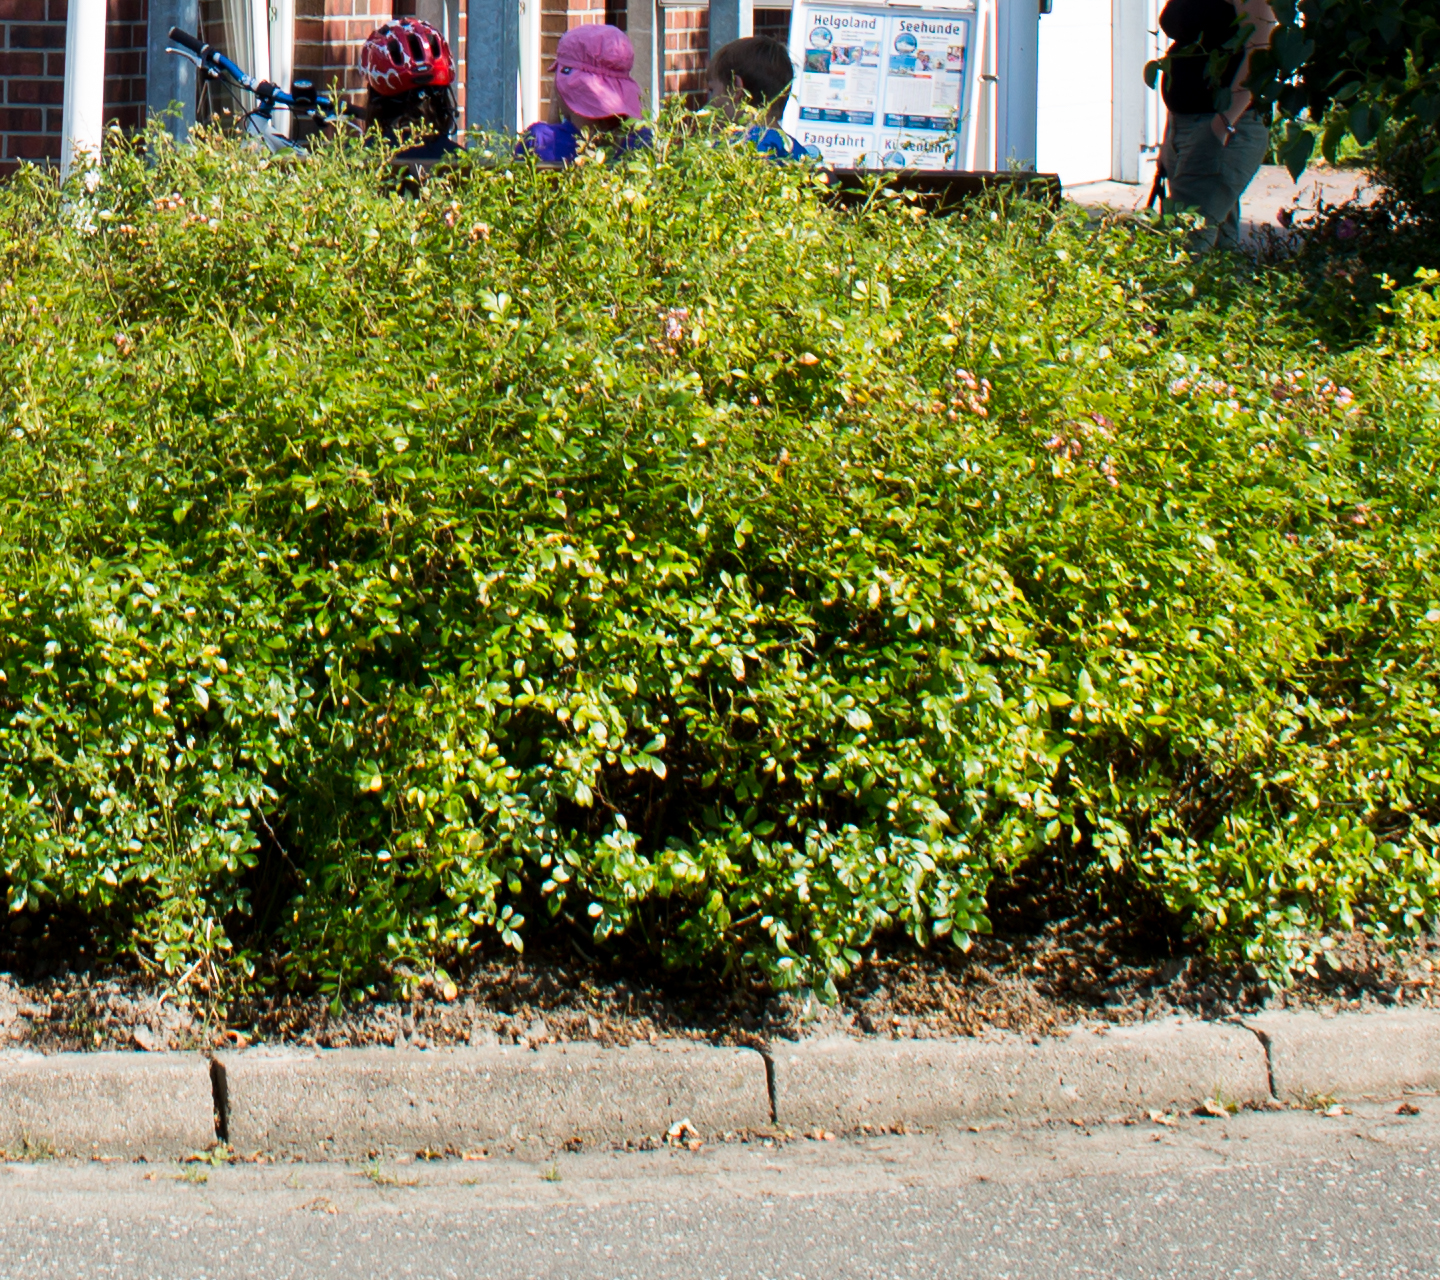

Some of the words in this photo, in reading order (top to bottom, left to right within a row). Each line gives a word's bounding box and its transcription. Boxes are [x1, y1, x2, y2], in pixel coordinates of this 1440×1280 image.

[813, 14, 876, 29] Helgoland
[899, 20, 960, 35] Seehunde
[804, 131, 865, 148] Fangfahrt
